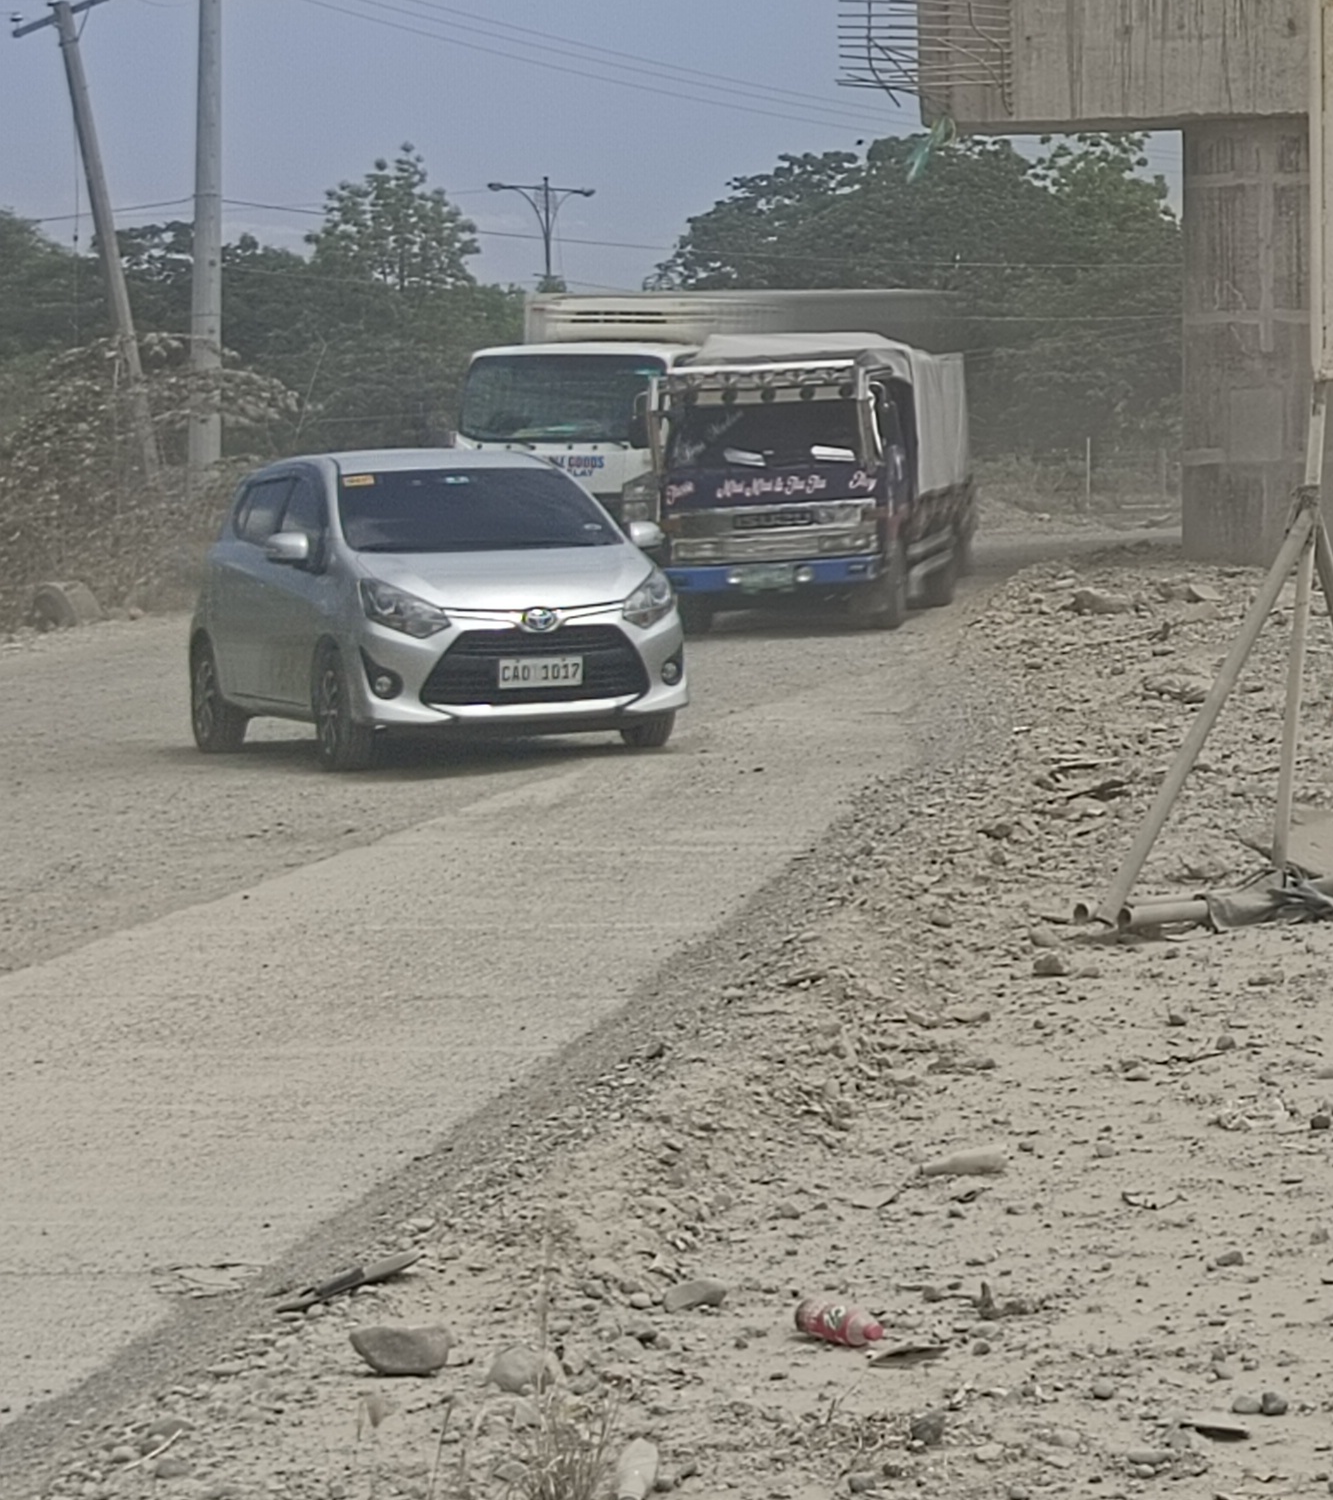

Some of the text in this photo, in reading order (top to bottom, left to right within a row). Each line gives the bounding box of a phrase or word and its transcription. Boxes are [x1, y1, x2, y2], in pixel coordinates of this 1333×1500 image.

[568, 454, 605, 469] GOODS
[735, 512, 812, 528] ISUZU
[541, 662, 580, 680] 1017
